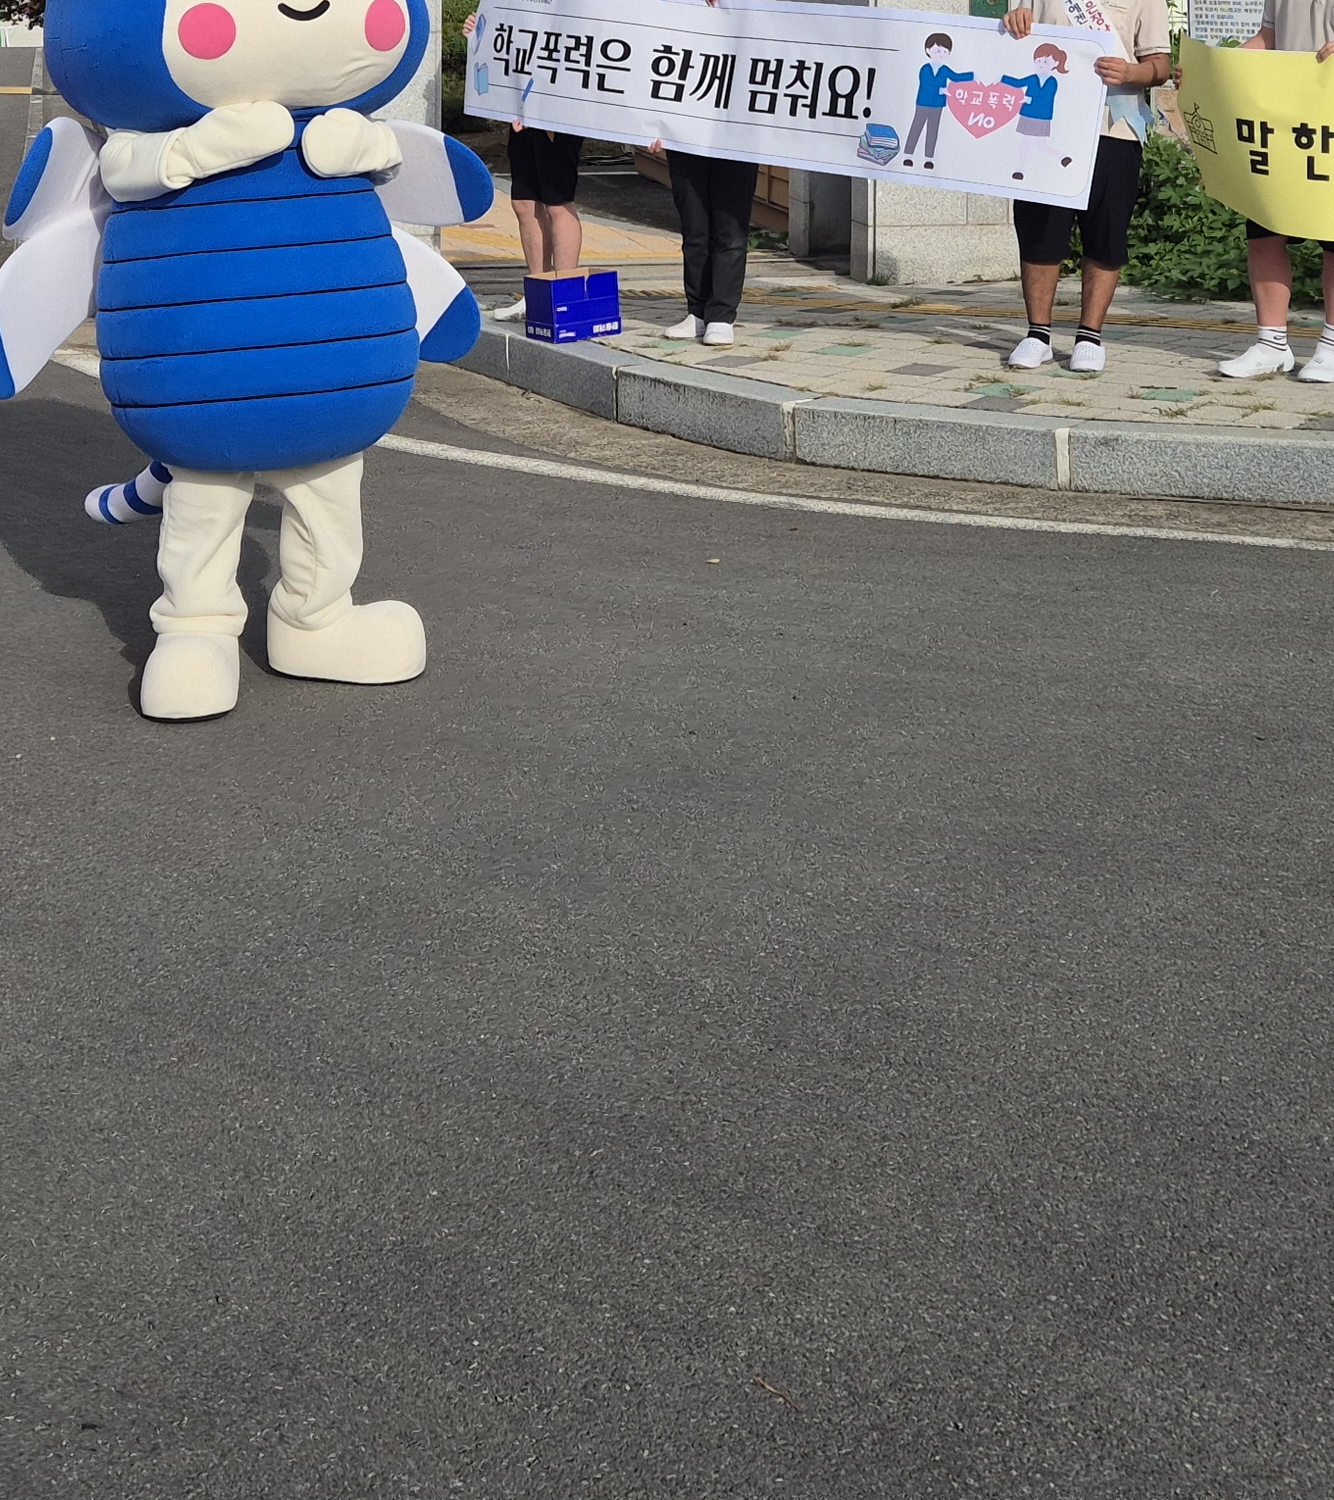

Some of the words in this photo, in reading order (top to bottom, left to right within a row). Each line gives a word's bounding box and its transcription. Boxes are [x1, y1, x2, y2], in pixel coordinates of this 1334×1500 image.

[493, 23, 632, 95] 학교폭력은
[650, 44, 737, 111] 함께
[748, 57, 876, 120] 멈춰요!
[956, 88, 1015, 112] 학교폭력
[1235, 118, 1275, 176] 말
